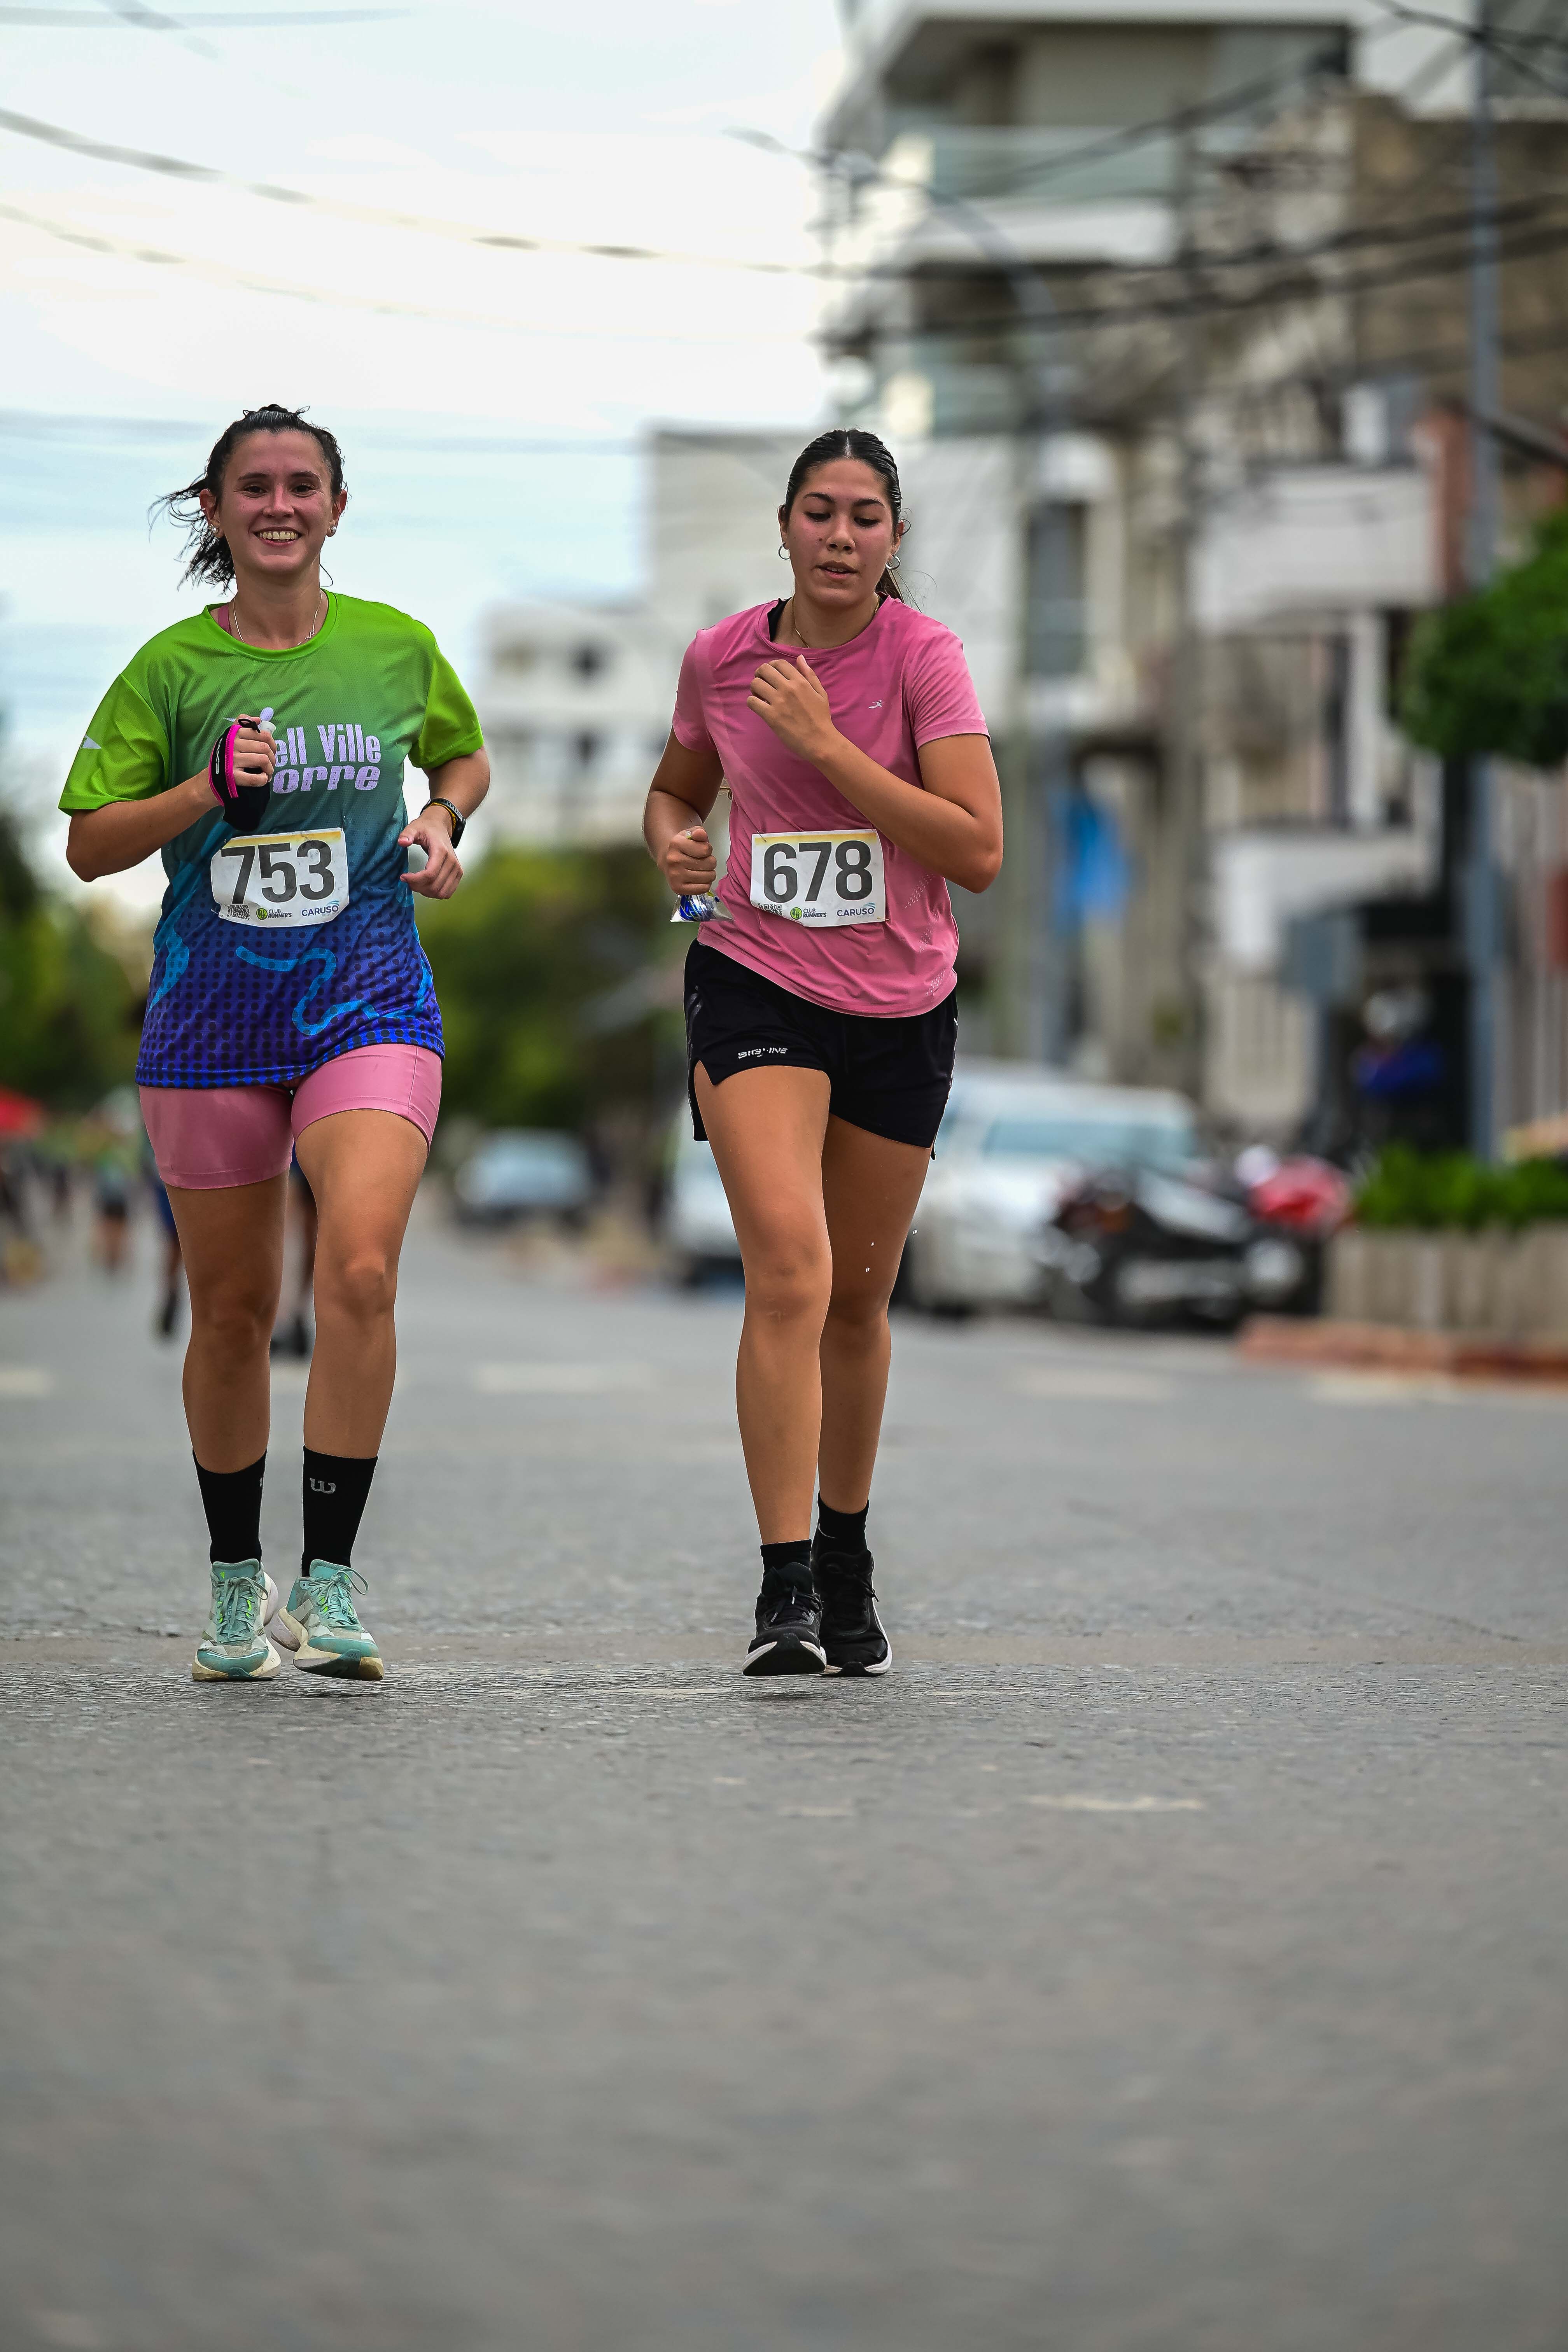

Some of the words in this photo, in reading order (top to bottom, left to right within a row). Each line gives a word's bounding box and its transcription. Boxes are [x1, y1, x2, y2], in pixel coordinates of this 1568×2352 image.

[274, 727, 307, 767] ell
[317, 724, 382, 763] Ville
[272, 765, 380, 794] orre
[221, 840, 335, 904] 753
[764, 840, 873, 903] 678
[301, 905, 339, 916] CARUSO
[837, 908, 874, 917] CARUSO
